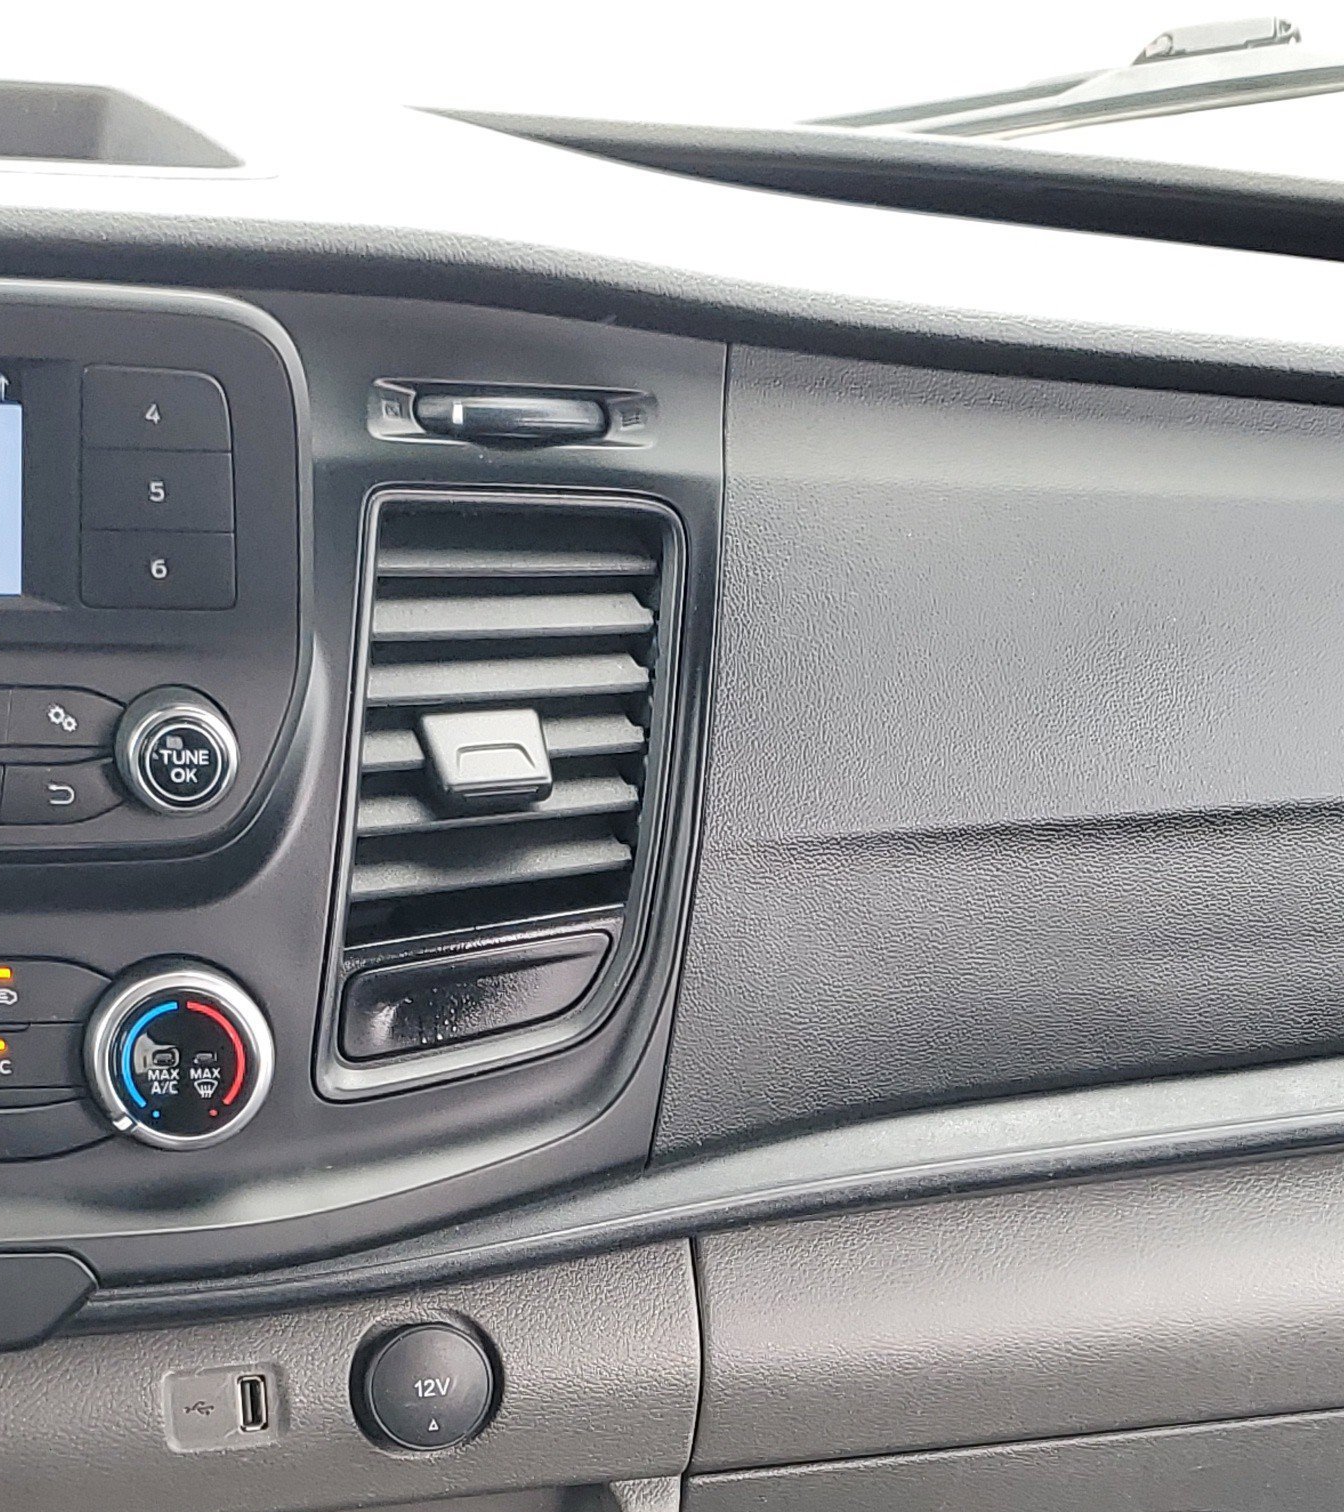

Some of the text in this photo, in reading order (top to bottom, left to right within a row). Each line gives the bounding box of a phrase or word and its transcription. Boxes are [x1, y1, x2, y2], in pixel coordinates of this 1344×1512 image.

[145, 404, 161, 424] 4
[149, 481, 165, 502] 5
[151, 559, 167, 579] 6
[160, 749, 209, 765] TUNE
[171, 768, 197, 783] OK
[148, 1069, 180, 1080] MAX
[190, 1068, 221, 1079] MAX
[151, 1082, 179, 1094] A/C
[414, 1378, 451, 1397] 12V
